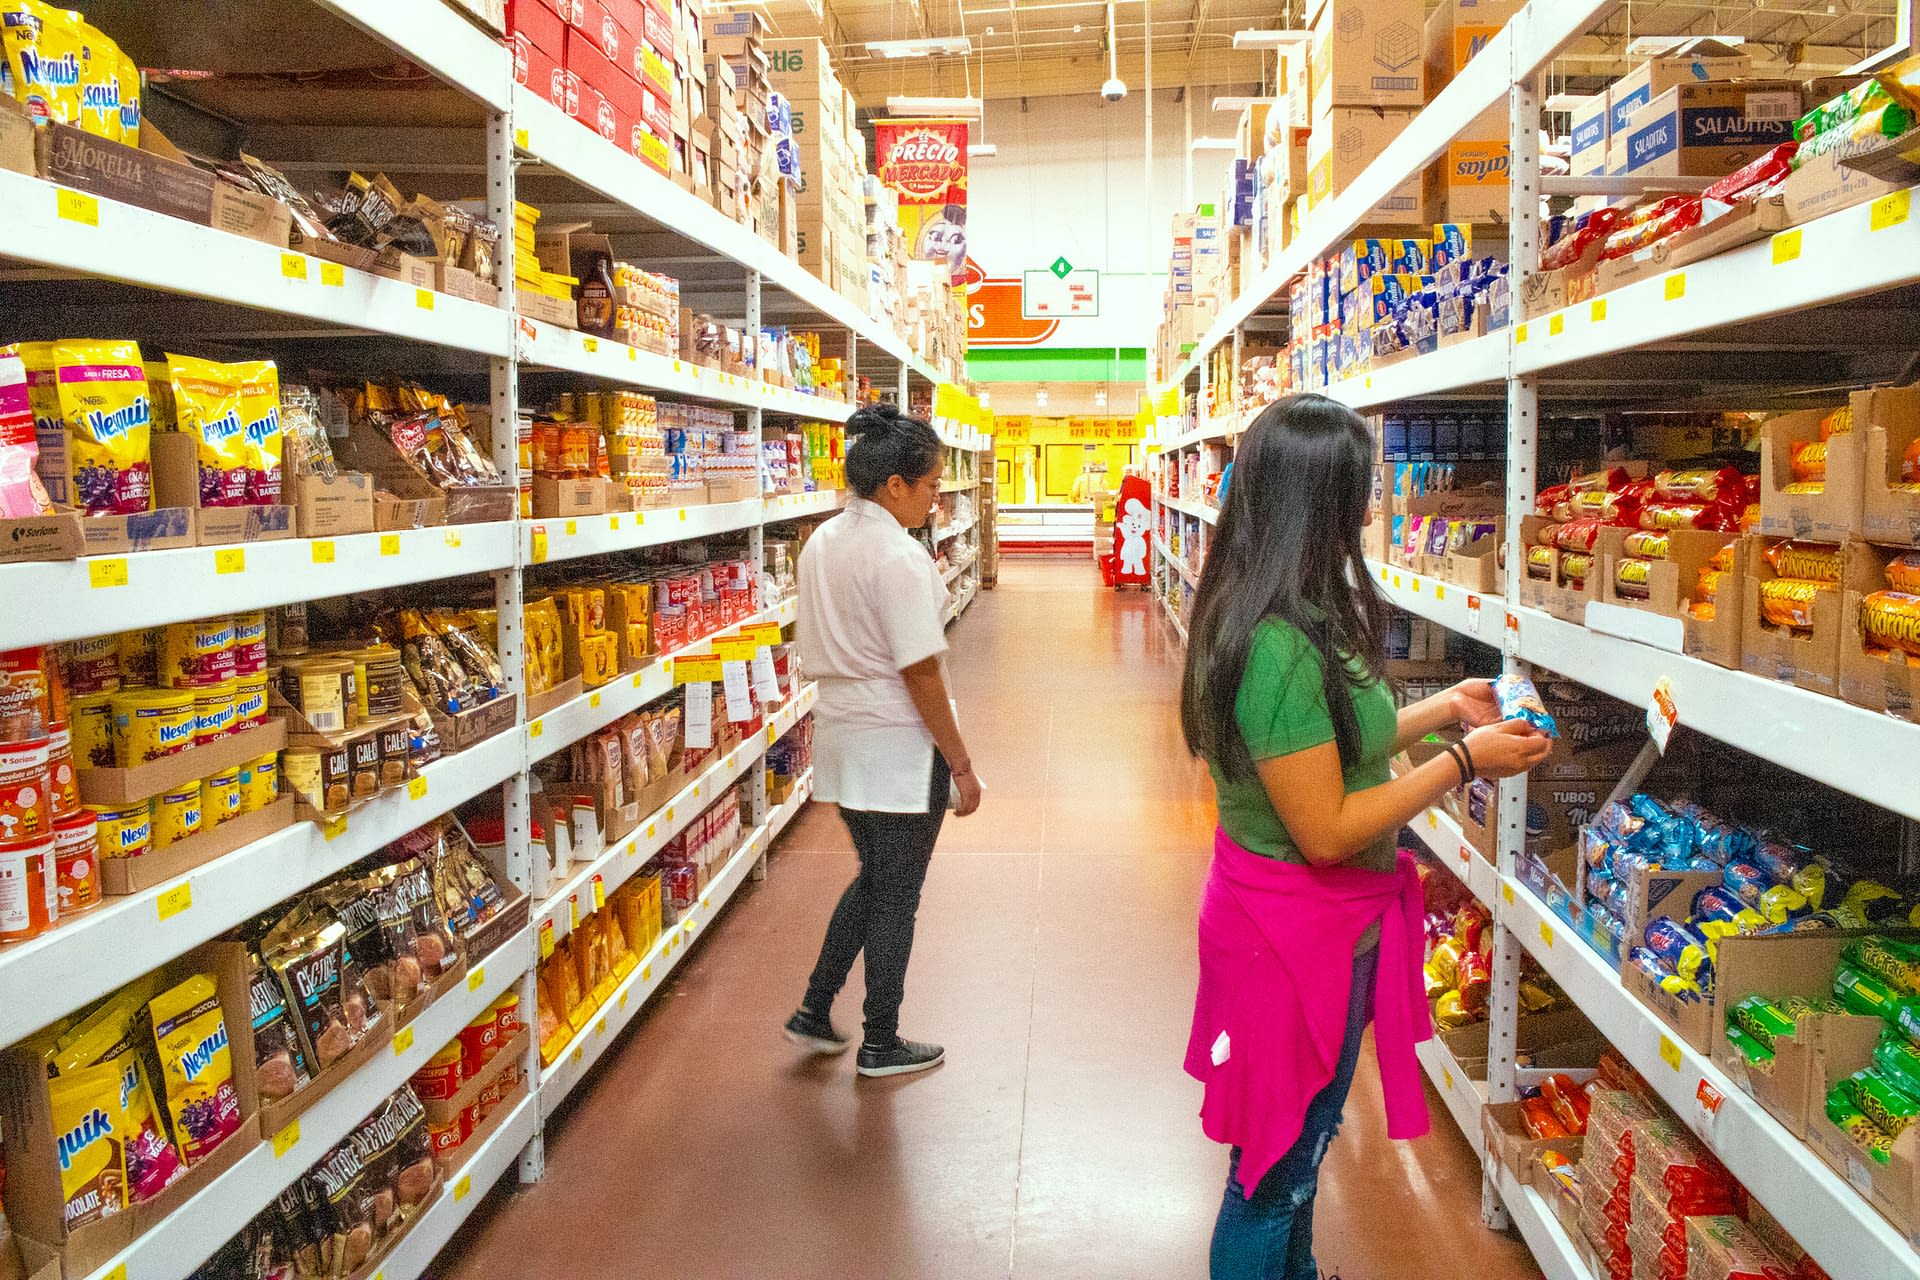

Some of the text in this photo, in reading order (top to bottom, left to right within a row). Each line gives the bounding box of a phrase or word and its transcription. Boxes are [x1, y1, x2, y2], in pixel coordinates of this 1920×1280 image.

[1695, 116, 1786, 137] SALADITAS
[1635, 124, 1668, 159] SALADITAS
[55, 135, 145, 184] MORELIA
[891, 143, 959, 163] PRECIO
[884, 165, 964, 183] MERCADO
[102, 368, 131, 379] FRESA
[26, 525, 59, 538] Soriana
[1554, 705, 1597, 717] TUBOS
[9, 755, 37, 766] Soriana
[1553, 791, 1595, 804] TUBOS
[64, 829, 89, 841] Soriana
